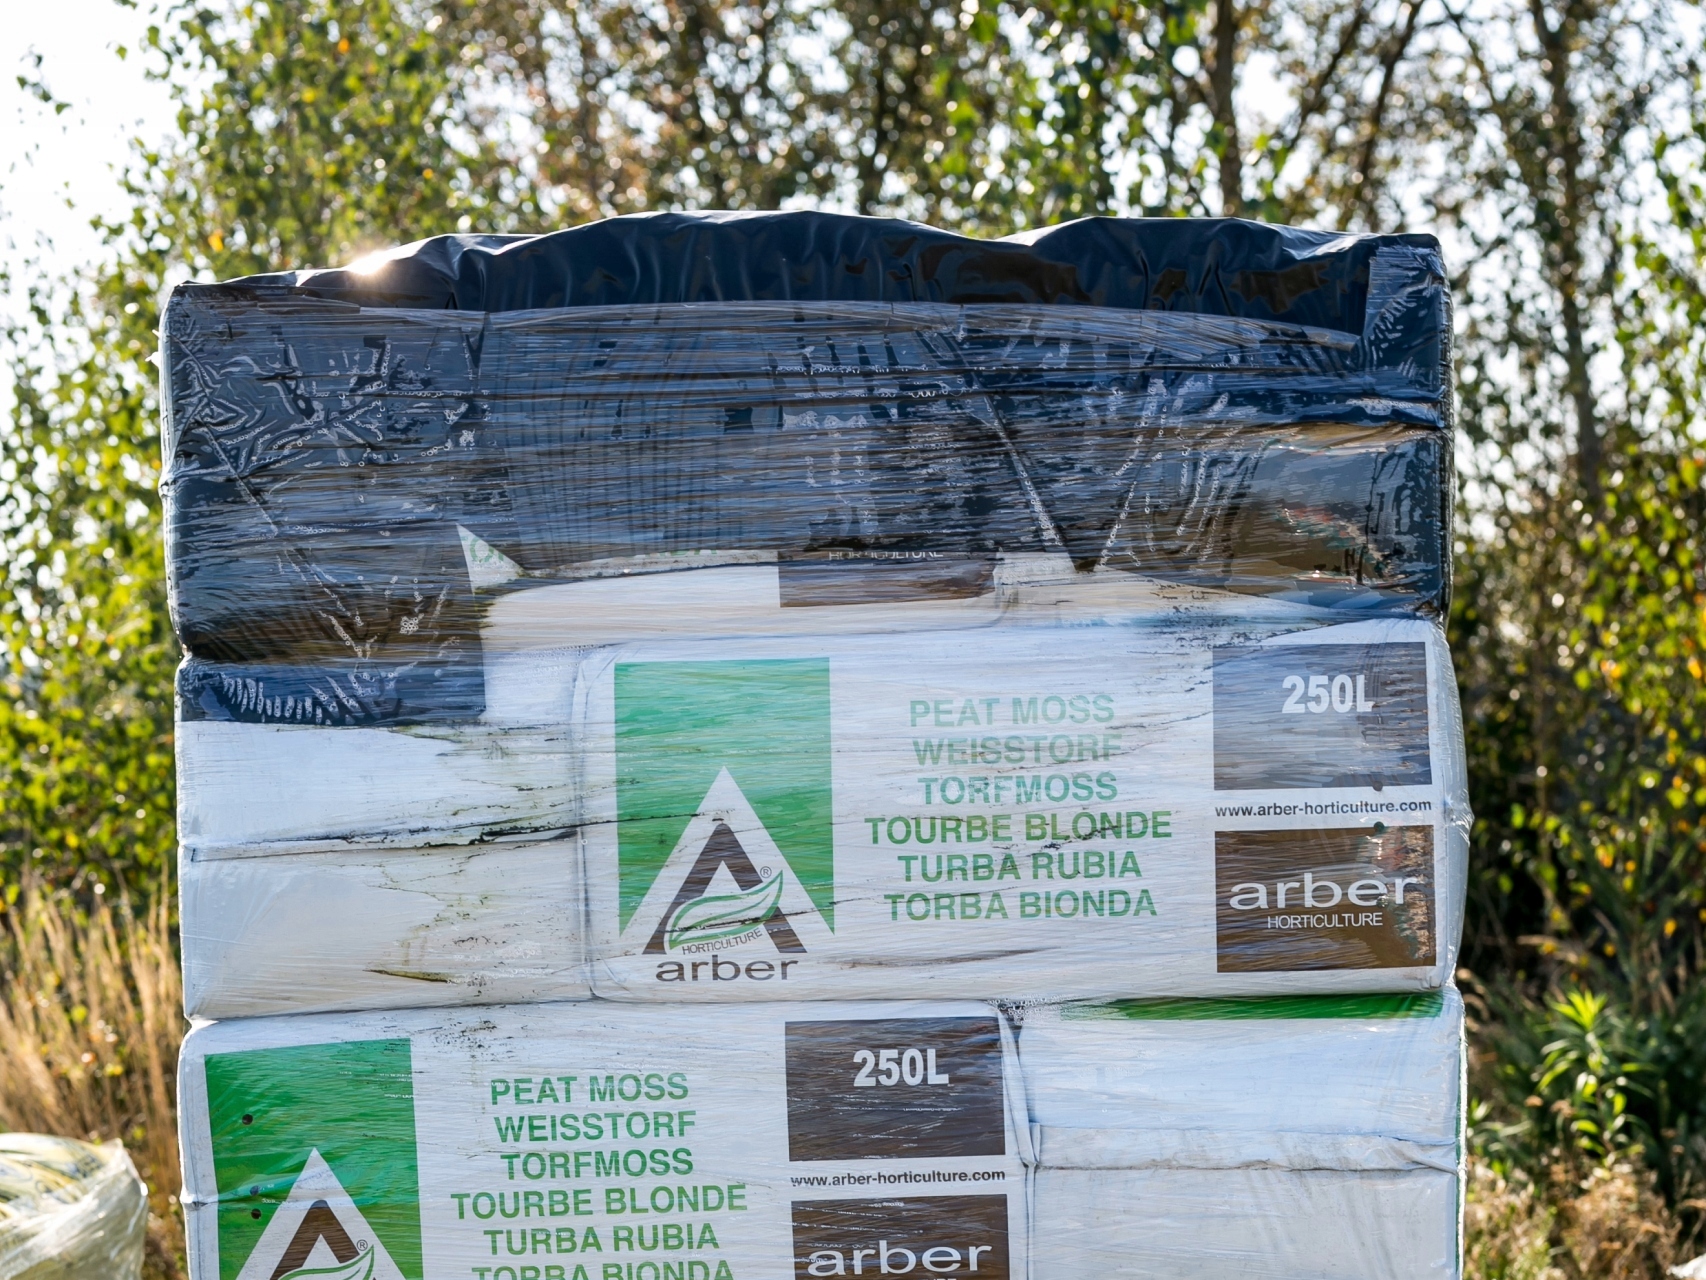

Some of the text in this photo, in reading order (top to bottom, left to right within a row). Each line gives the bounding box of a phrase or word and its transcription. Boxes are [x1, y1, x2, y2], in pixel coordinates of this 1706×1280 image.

[910, 694, 1114, 727] PEAT MOSS
[1282, 674, 1373, 714] 250L
[912, 734, 1122, 766] WEISSTORF
[918, 771, 1117, 806] TORFMOSS
[1215, 800, 1432, 817] www.arber-horticulture.com
[865, 810, 1172, 845] TOURBE BLONDE
[897, 851, 1142, 882] TURBA RUBIA
[884, 889, 1157, 921] TORBA BIONDA
[1229, 872, 1417, 909] arber
[1267, 912, 1383, 929] HORTICULTURE
[682, 927, 763, 955] HORTICULTURE
[655, 956, 799, 981] arber
[853, 1048, 949, 1087] 250L
[490, 1072, 688, 1105] PEAT MOSS
[494, 1110, 696, 1143] WEISSTORF
[501, 1148, 693, 1180] TORFMOSS
[791, 1170, 1006, 1187] www.arber-horticulture.com
[451, 1184, 747, 1220] TOURBE BLONDE
[483, 1223, 720, 1256] TURBA RUBIA
[808, 1240, 992, 1276] arber
